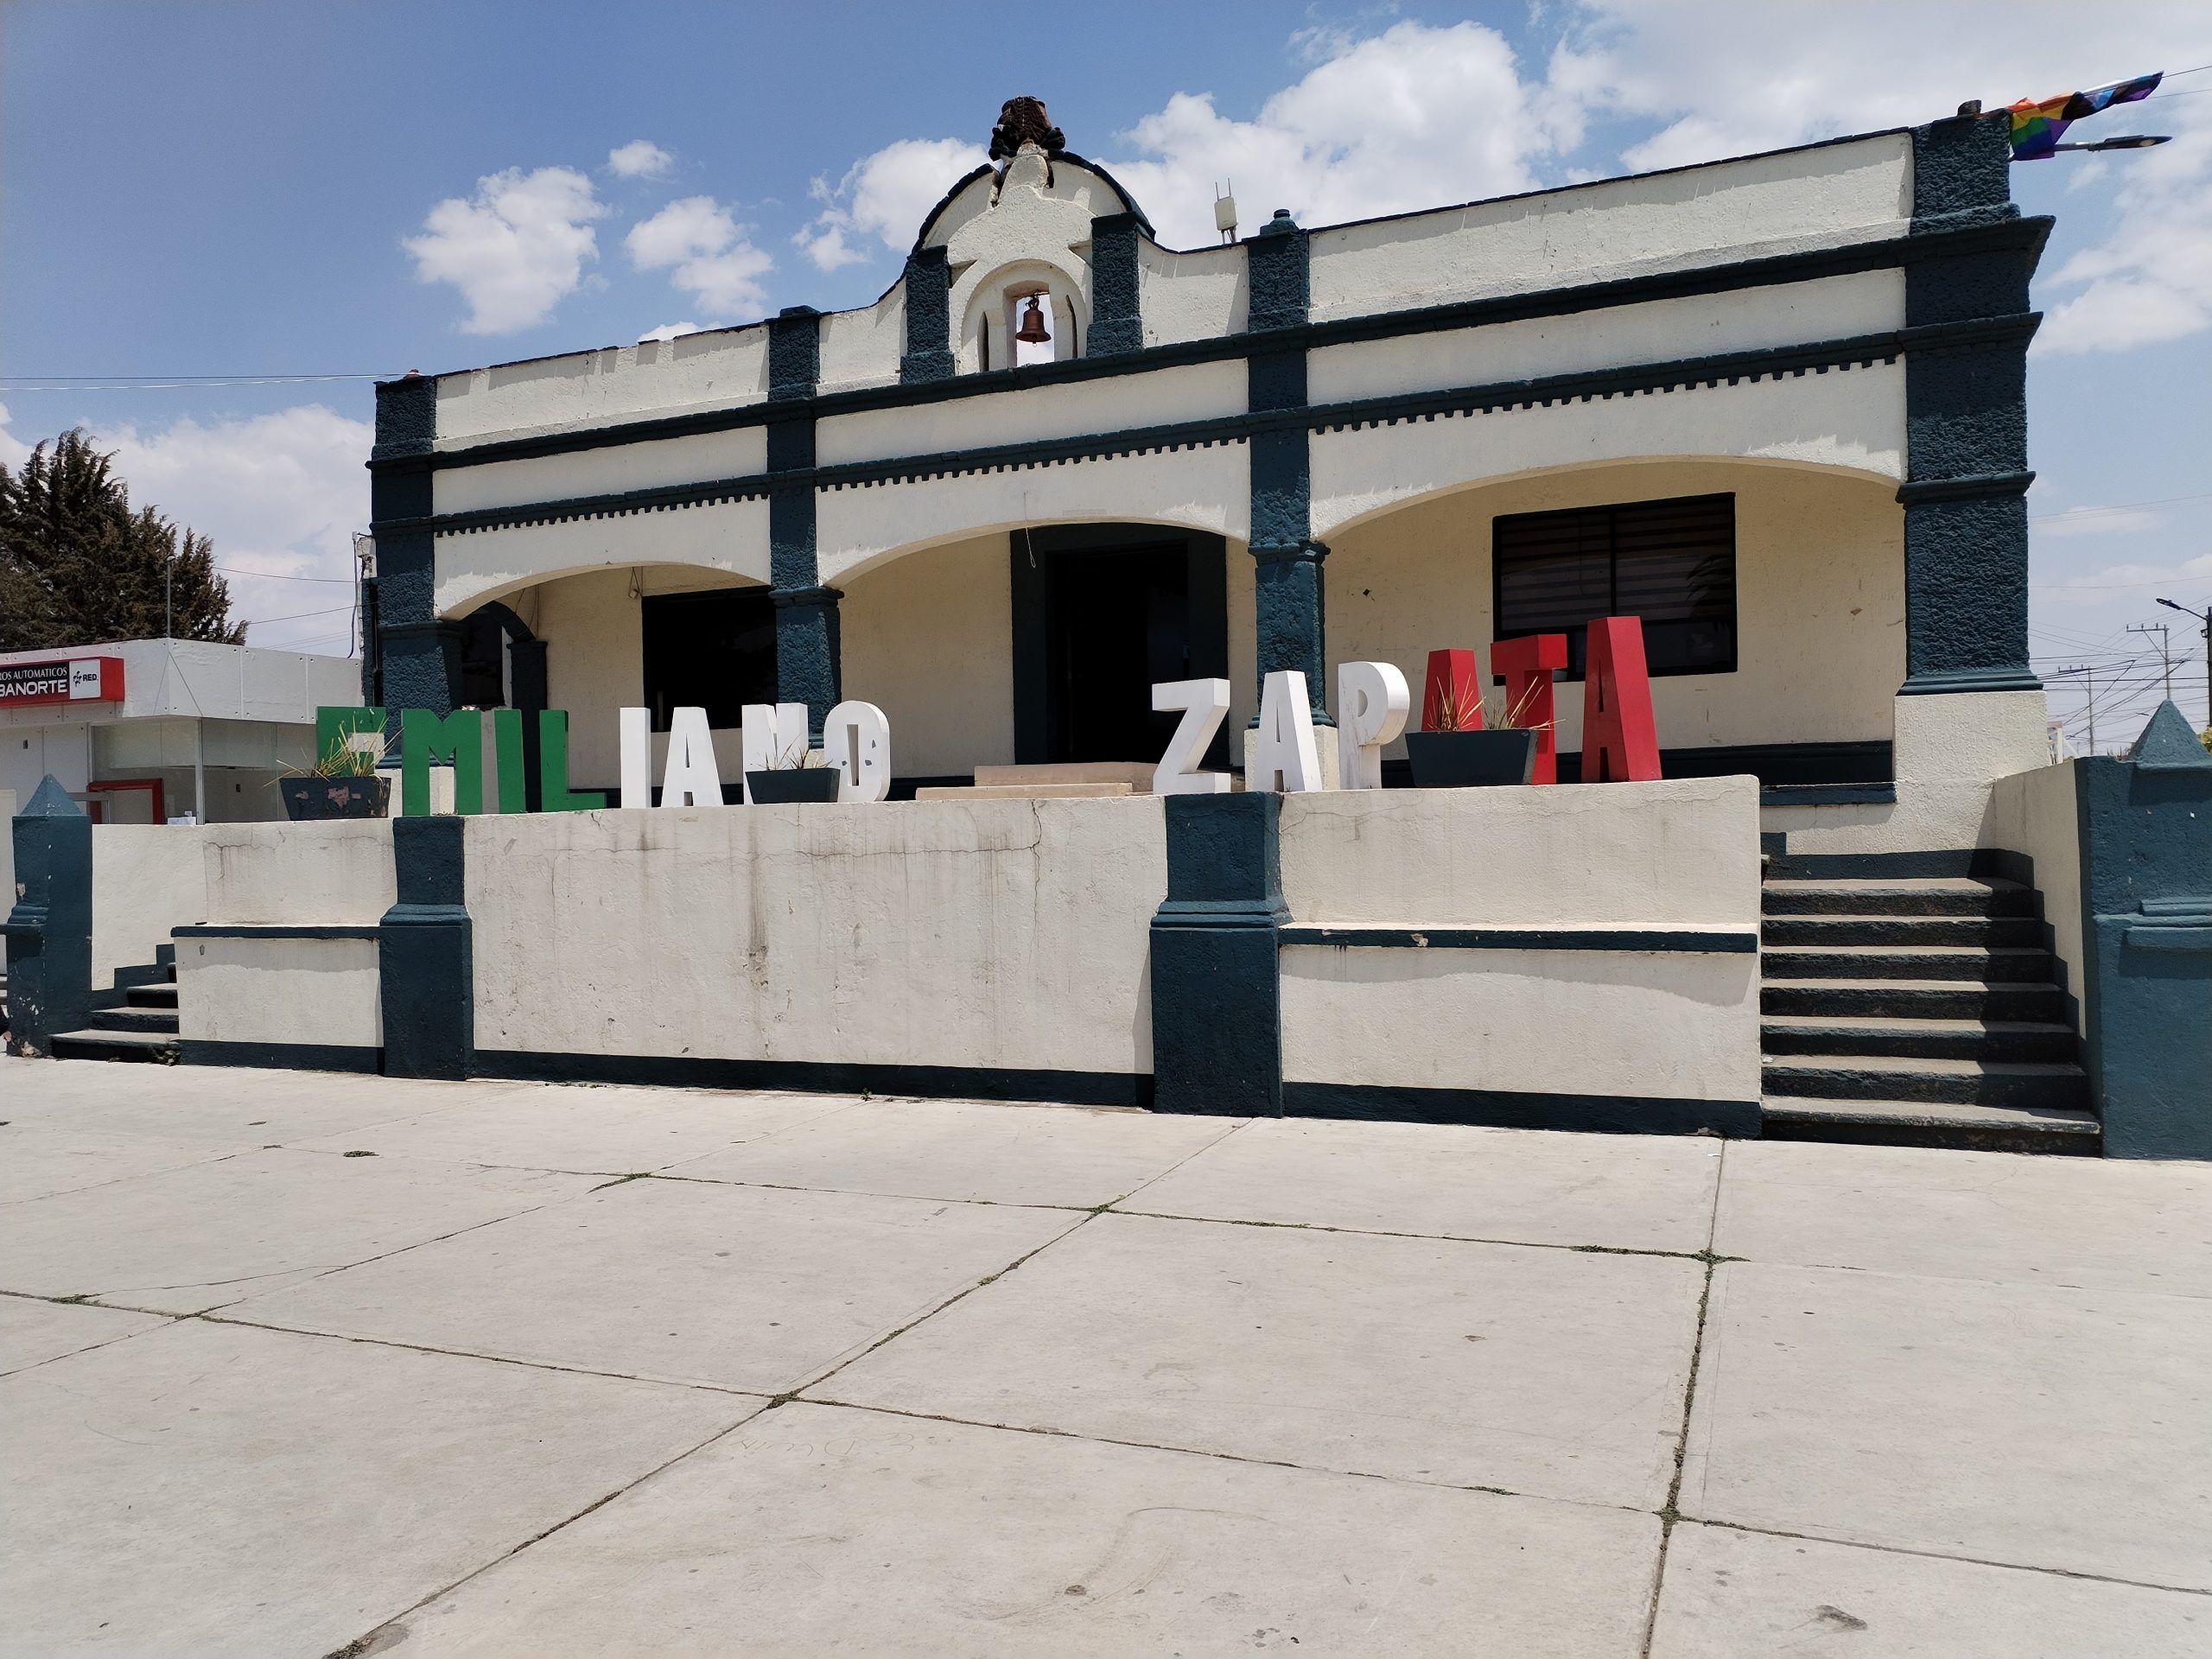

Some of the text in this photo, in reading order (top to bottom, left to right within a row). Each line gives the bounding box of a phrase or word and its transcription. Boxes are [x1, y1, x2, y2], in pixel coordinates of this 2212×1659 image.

[13, 667, 67, 679] AUTOMATICOS
[82, 673, 98, 682] RED
[1152, 616, 1662, 792] ZAPATA
[316, 700, 891, 817] EMILIANO
